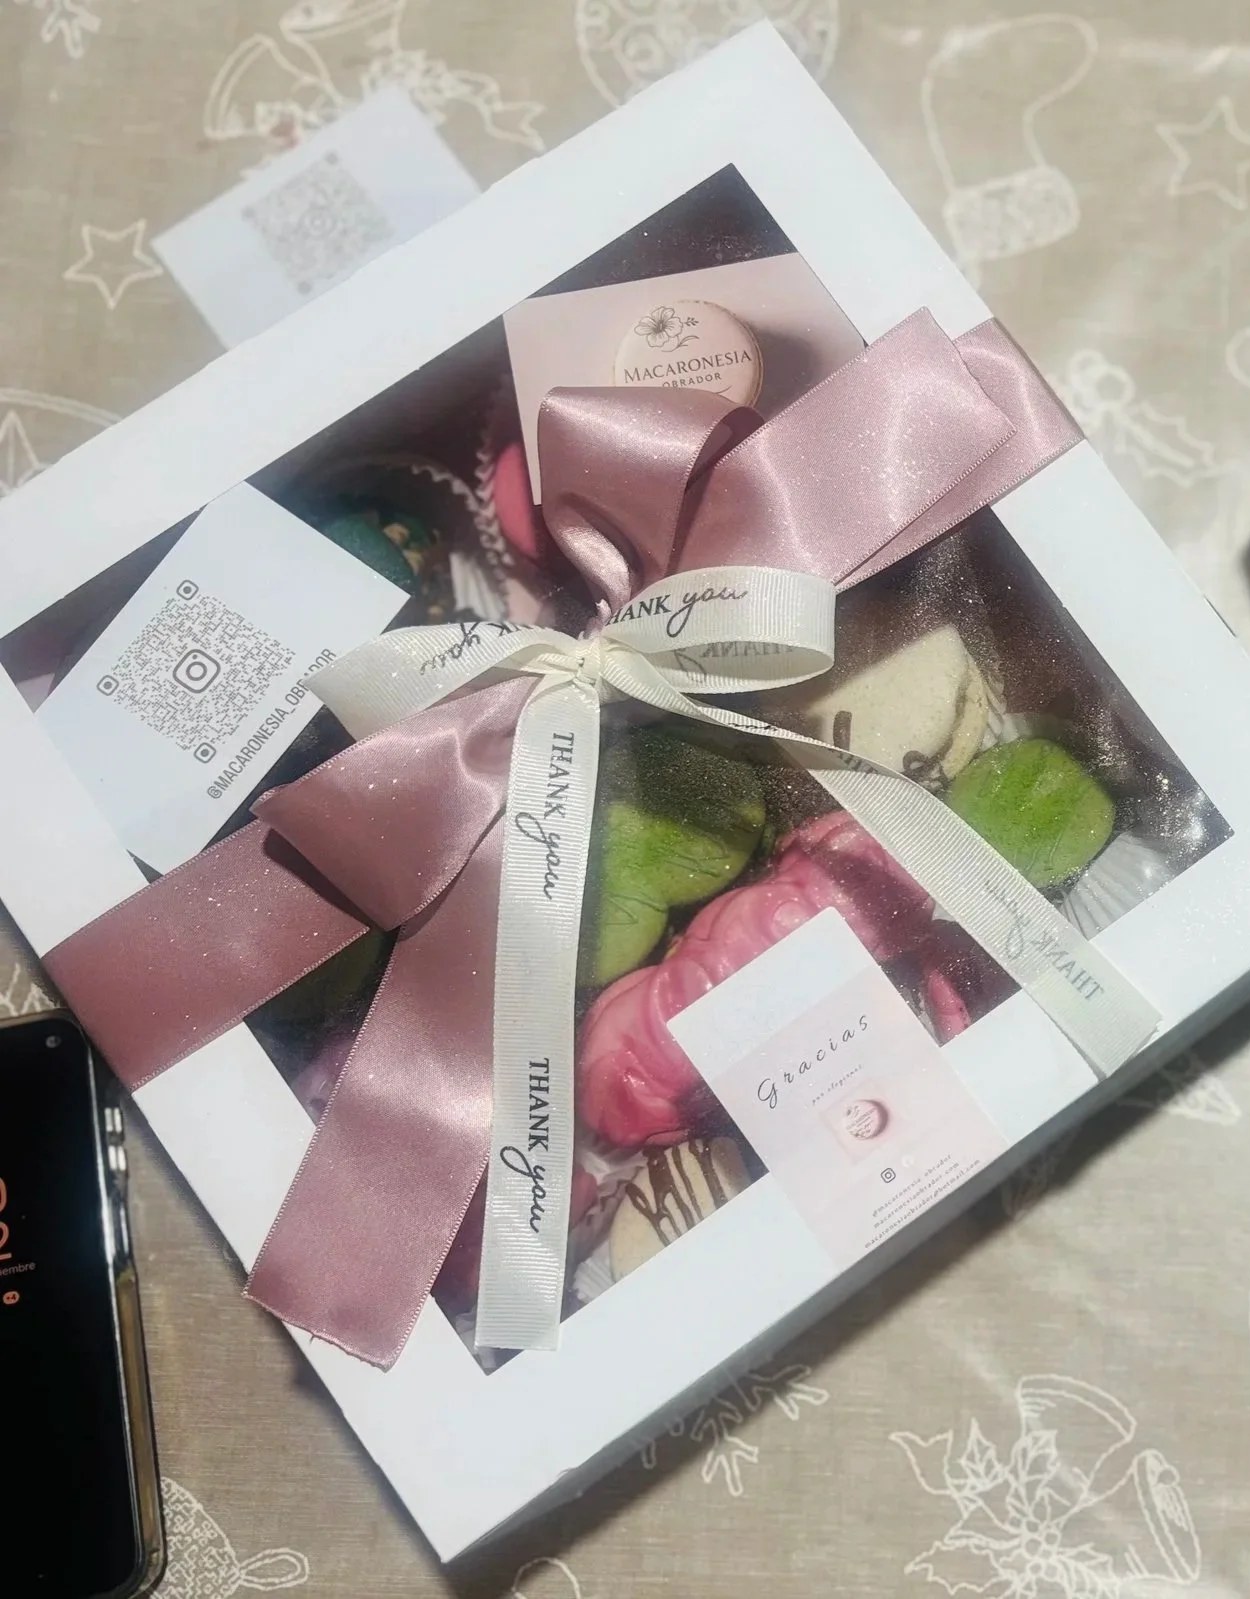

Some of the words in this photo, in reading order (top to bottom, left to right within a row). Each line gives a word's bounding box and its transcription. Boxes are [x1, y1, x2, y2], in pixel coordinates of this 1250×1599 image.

[624, 350, 752, 384] MACARONESIA
[662, 372, 722, 389] OBRADOR
[605, 594, 672, 626] HANK
[666, 588, 748, 638] you
[207, 648, 337, 799] @MACARONESIA_OBRDOR
[543, 732, 575, 819] THANK
[515, 811, 561, 900] you
[528, 1057, 550, 1152] THANK
[757, 1014, 868, 1109] Gracias
[499, 1146, 546, 1234] you
